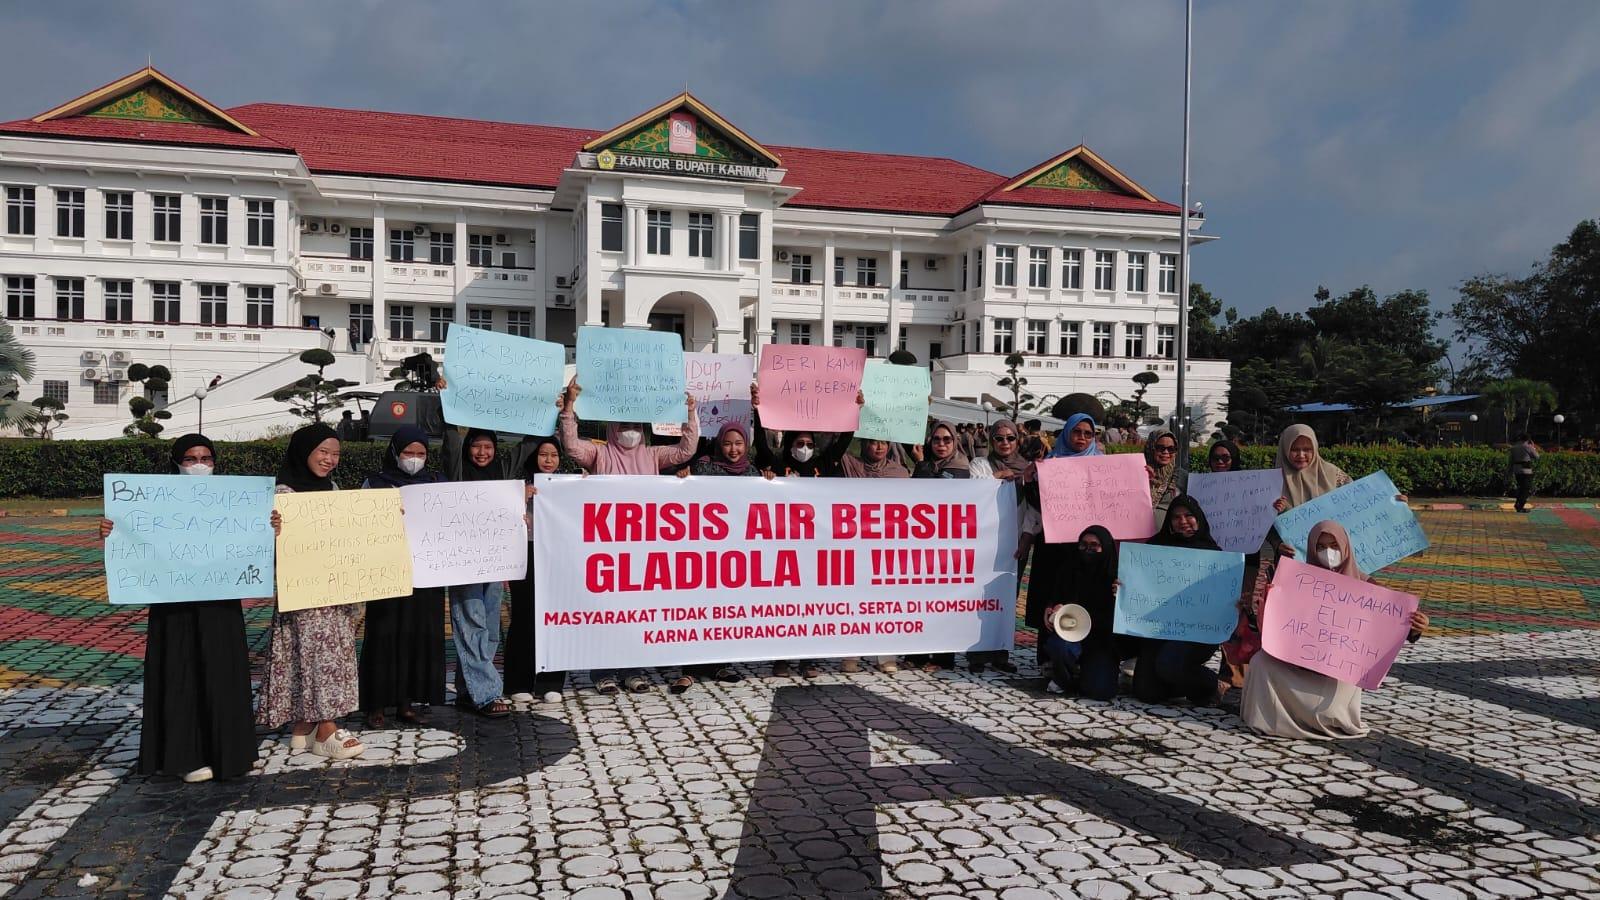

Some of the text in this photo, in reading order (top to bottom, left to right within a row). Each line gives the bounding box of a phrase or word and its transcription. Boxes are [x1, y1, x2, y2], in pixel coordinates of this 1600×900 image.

[620, 155, 770, 179] KANTOR BUPATI KARIMUN
[457, 336, 498, 360] PAK
[685, 360, 721, 381] IDUP
[773, 354, 859, 372] BERI KAMI
[686, 381, 734, 392] SEHAT
[781, 379, 857, 396] AIR BERSIH
[112, 480, 271, 510] BAPAK BUPATI
[424, 488, 488, 512] PAJAK
[1281, 503, 1322, 530] BAPAK
[1330, 483, 1370, 505] BUPATI
[126, 510, 266, 536] TERSAYANG
[583, 503, 977, 542] KRISIS AIR BERSIH
[421, 531, 451, 545] AIR
[112, 542, 272, 560] HATI KAMI RESAH
[117, 568, 159, 588] BILA
[168, 570, 195, 586] TAK
[203, 571, 230, 586] ADA
[585, 549, 801, 594] GLADIOLA
[817, 549, 855, 586] III
[1296, 573, 1403, 618] PERUMAHAN
[544, 608, 657, 626] MASYARAKAT
[661, 606, 709, 622] TIDAK
[712, 605, 747, 620] BISA
[859, 601, 903, 615] SERTA
[907, 600, 922, 613] DI
[1317, 605, 1369, 632] ELIT
[644, 620, 923, 644] KARNA KEKURANGAN AIR DAN KOTOR
[1281, 618, 1380, 660] AIR BERSIH
[1300, 644, 1361, 677] SULIT
